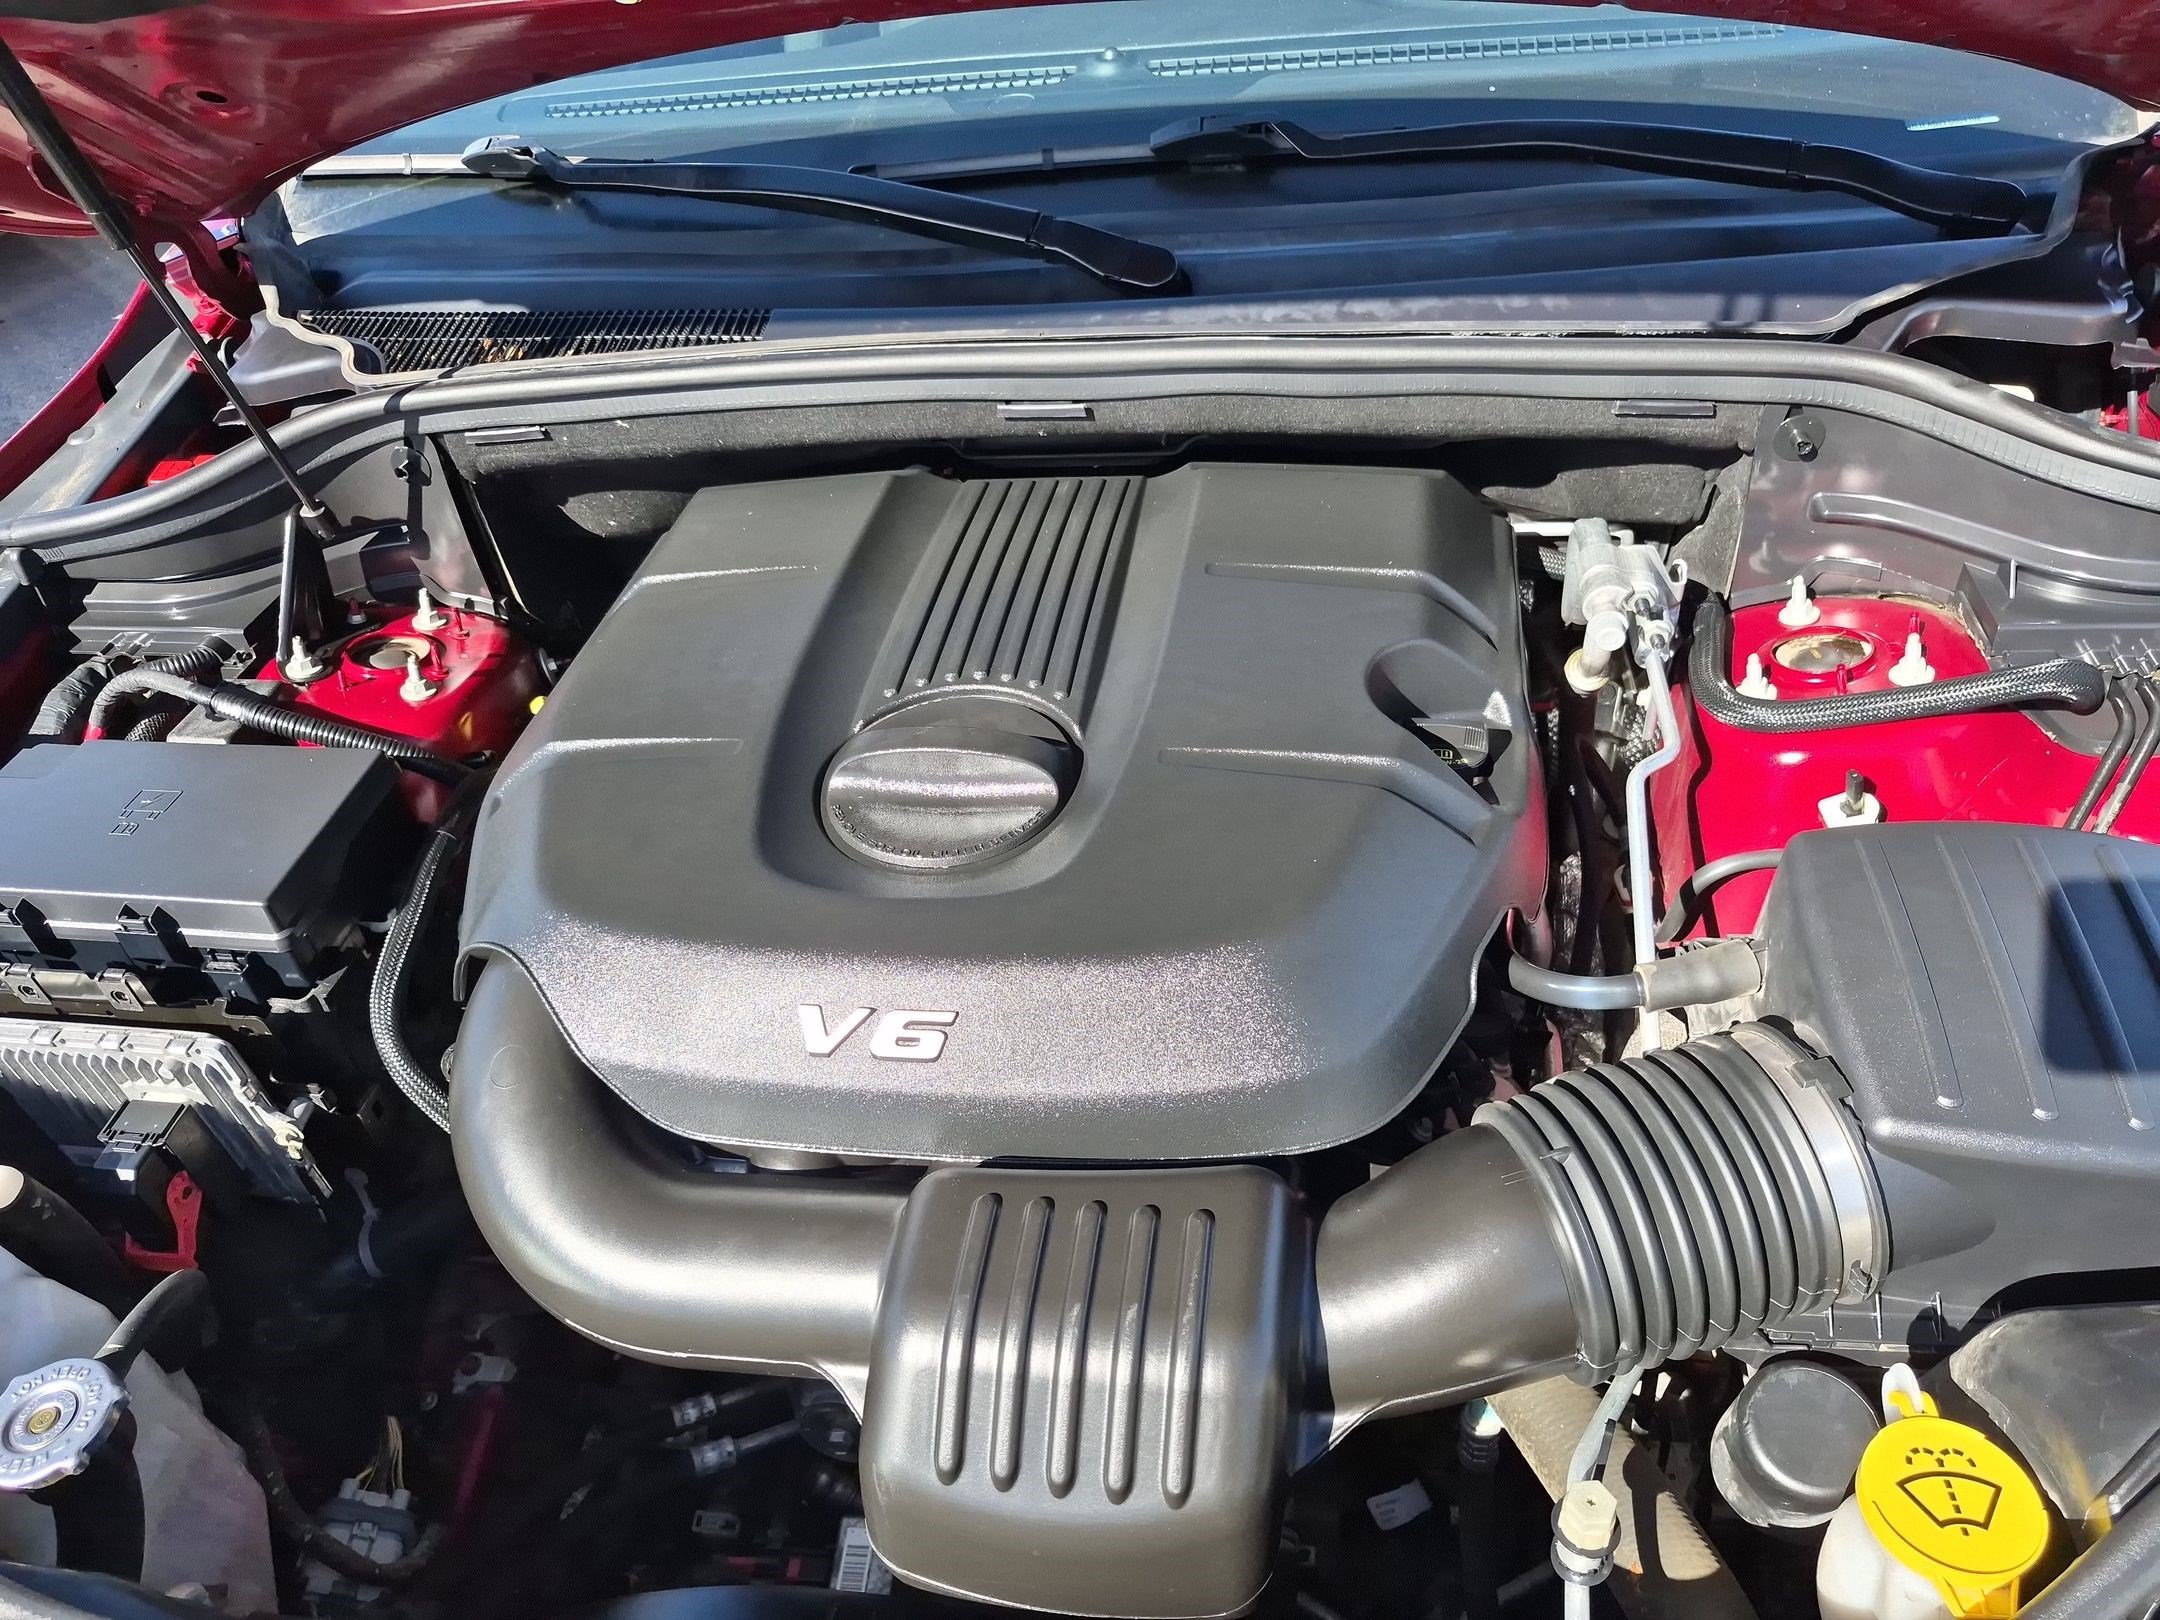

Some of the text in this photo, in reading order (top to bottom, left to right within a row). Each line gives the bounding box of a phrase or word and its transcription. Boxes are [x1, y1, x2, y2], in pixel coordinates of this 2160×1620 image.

[867, 839, 896, 854] FOR
[901, 848, 922, 858] OIL
[989, 808, 1048, 848] SERVICE
[798, 1003, 960, 1063] V6
